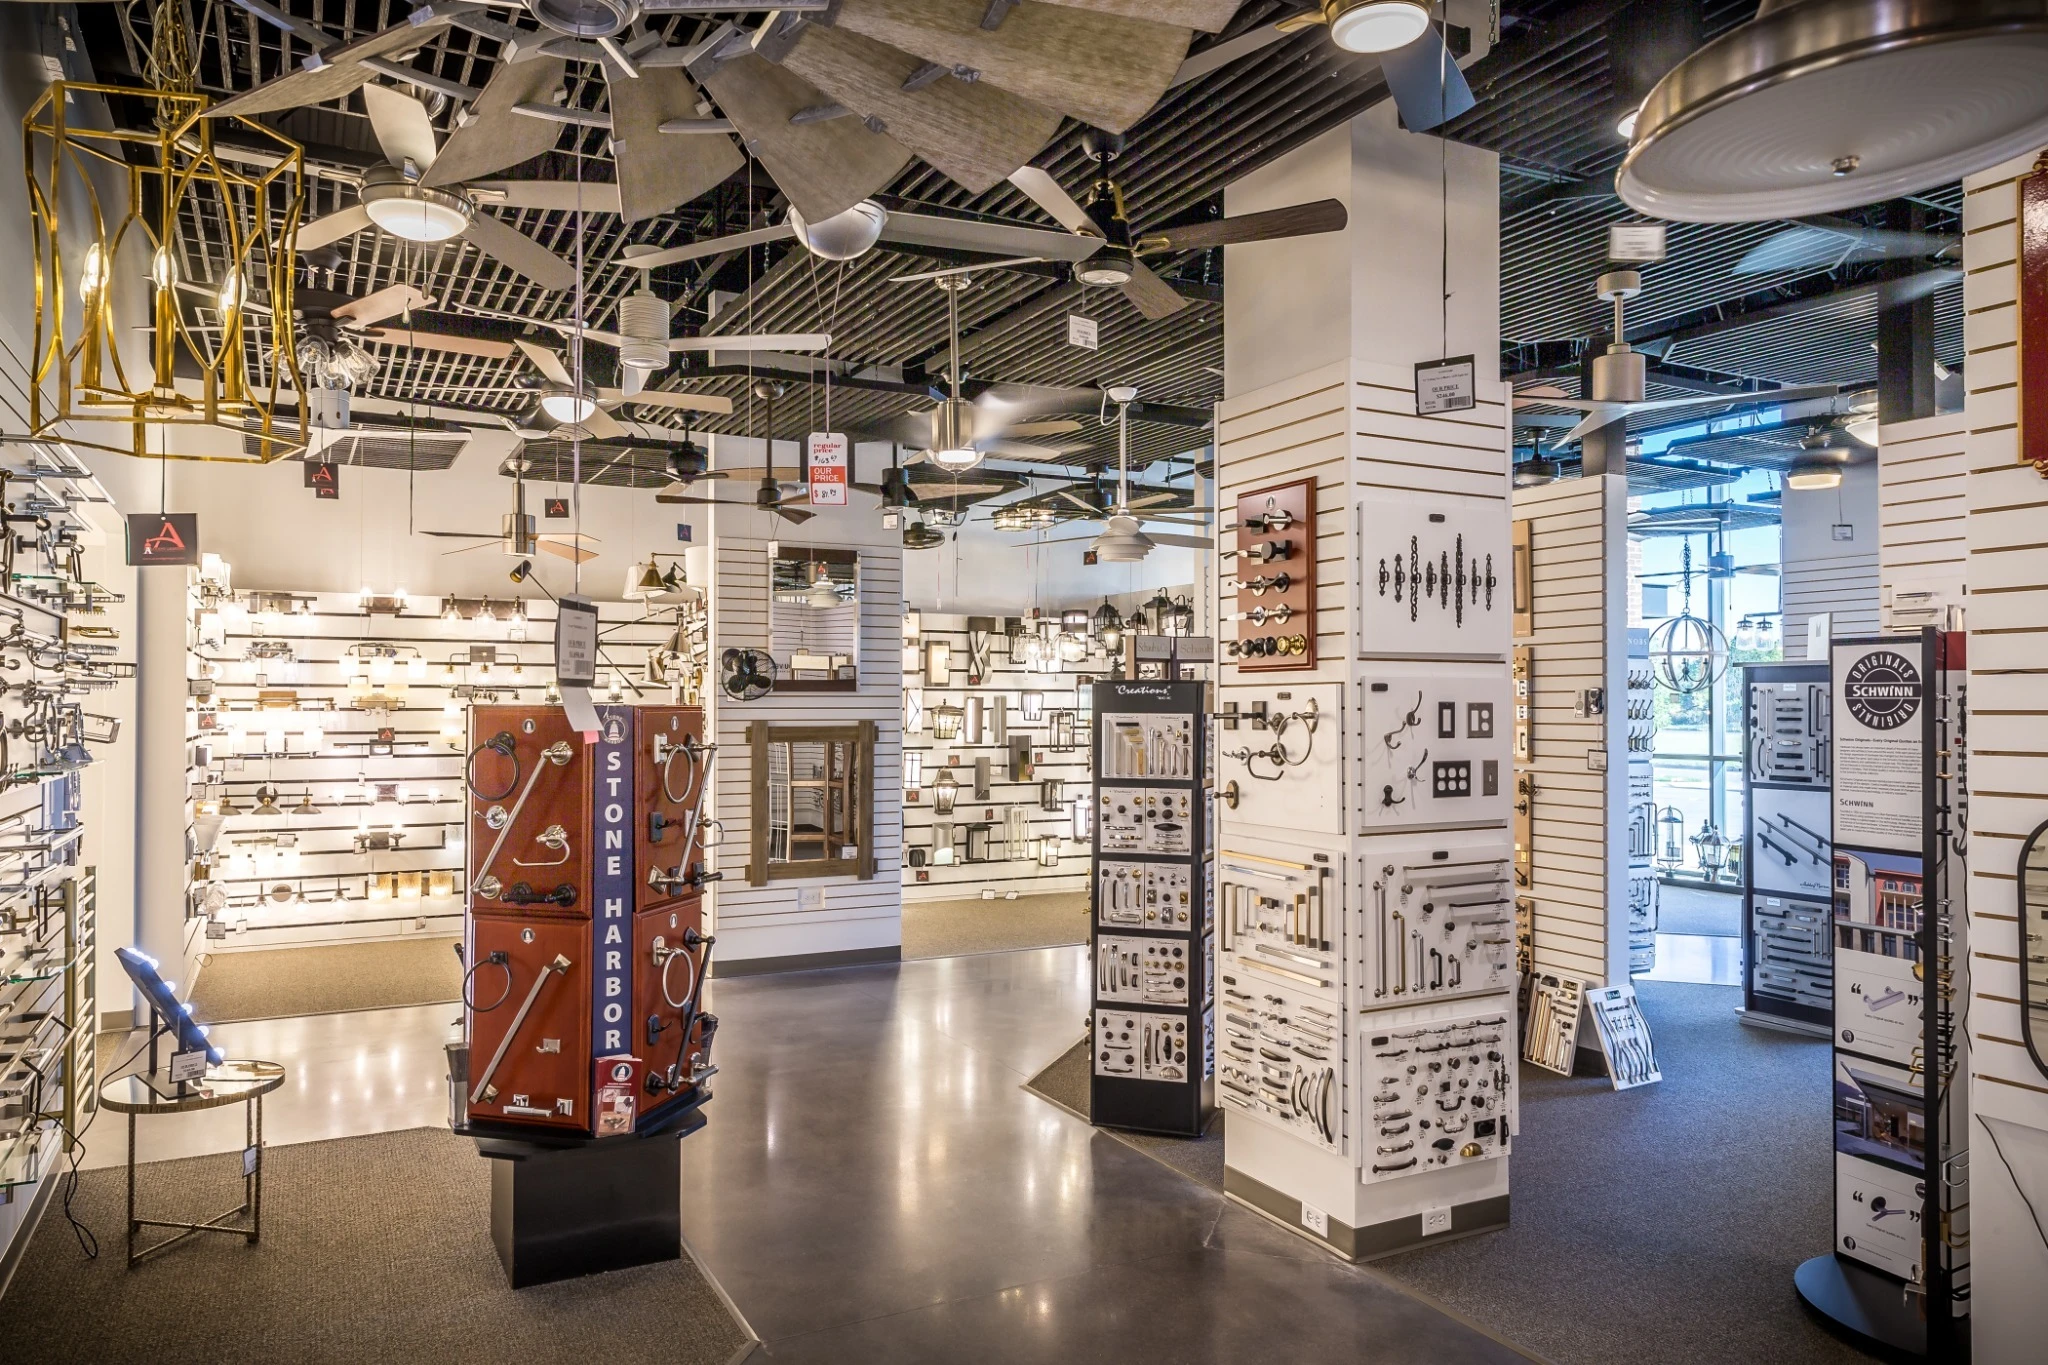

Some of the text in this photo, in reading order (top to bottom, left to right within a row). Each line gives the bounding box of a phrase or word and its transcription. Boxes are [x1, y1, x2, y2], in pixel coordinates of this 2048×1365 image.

[814, 474, 839, 482] PRICE
[1852, 654, 1914, 679] ORIGINALS
[1852, 684, 1914, 697] SCHWINN
[1852, 703, 1914, 727] ORIGINALS
[604, 751, 623, 876] STONE
[1839, 798, 1874, 808] SCHWINN
[603, 897, 623, 1050] HARBOR
